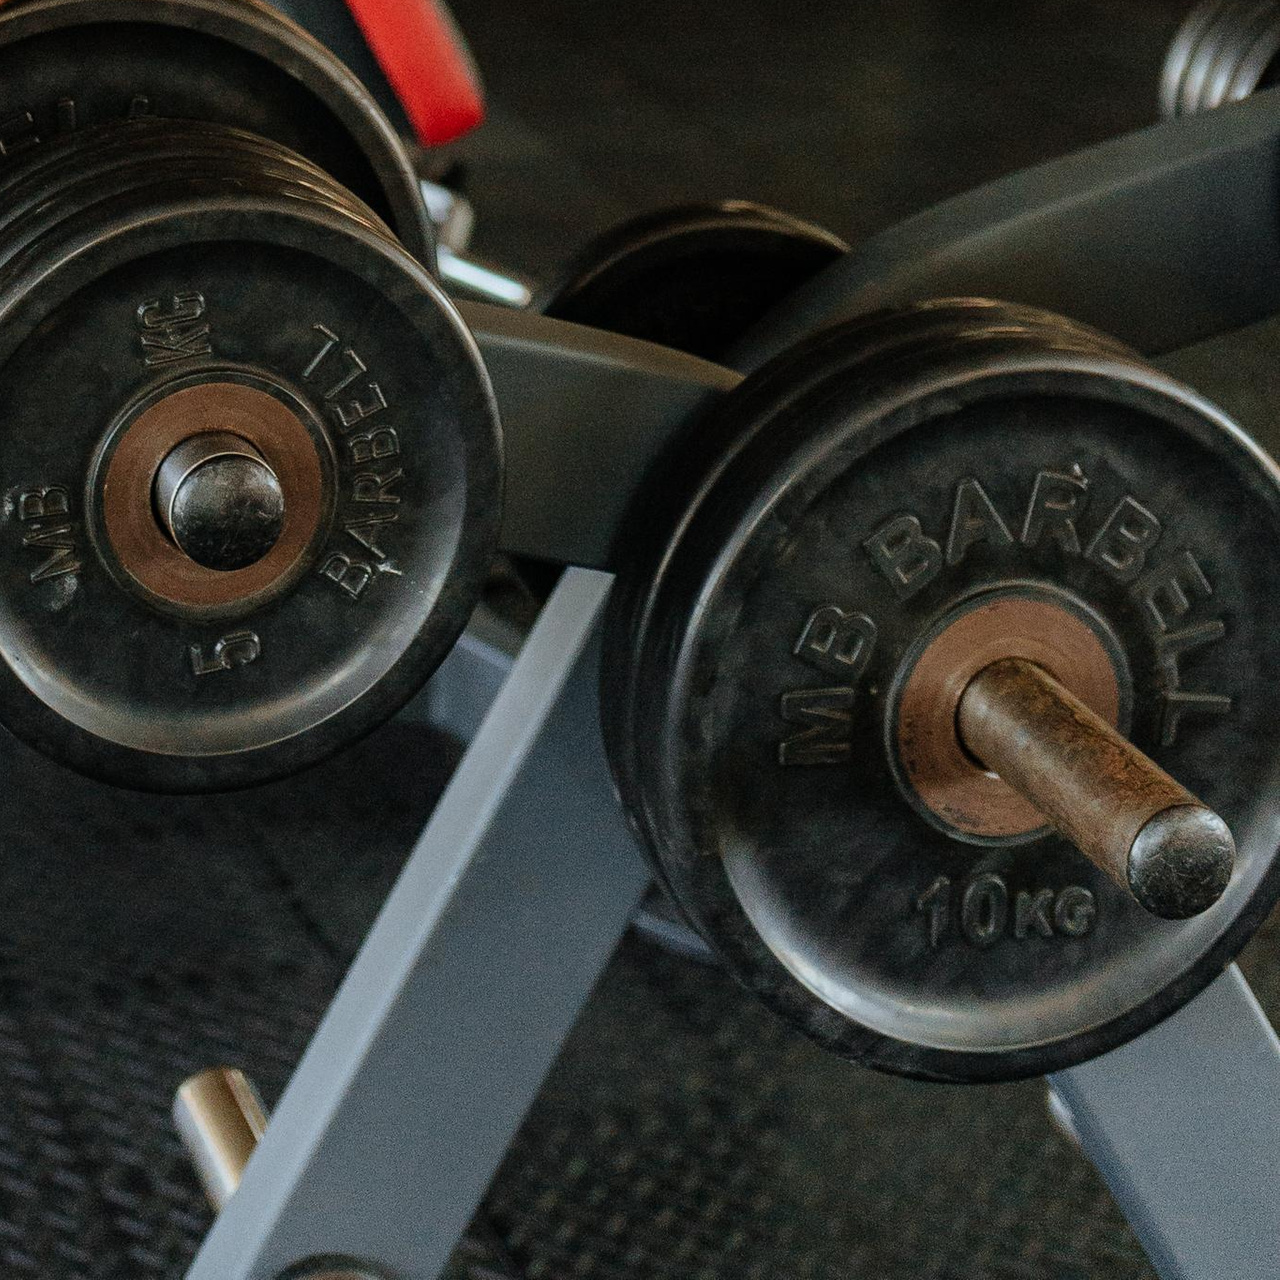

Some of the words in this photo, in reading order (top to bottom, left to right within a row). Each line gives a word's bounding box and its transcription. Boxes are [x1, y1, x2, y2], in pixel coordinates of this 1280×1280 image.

[136, 290, 212, 367] KG
[20, 481, 82, 585] MB
[302, 322, 404, 600] BARBELL
[779, 605, 878, 766] MB
[864, 467, 1232, 747] BARBELL
